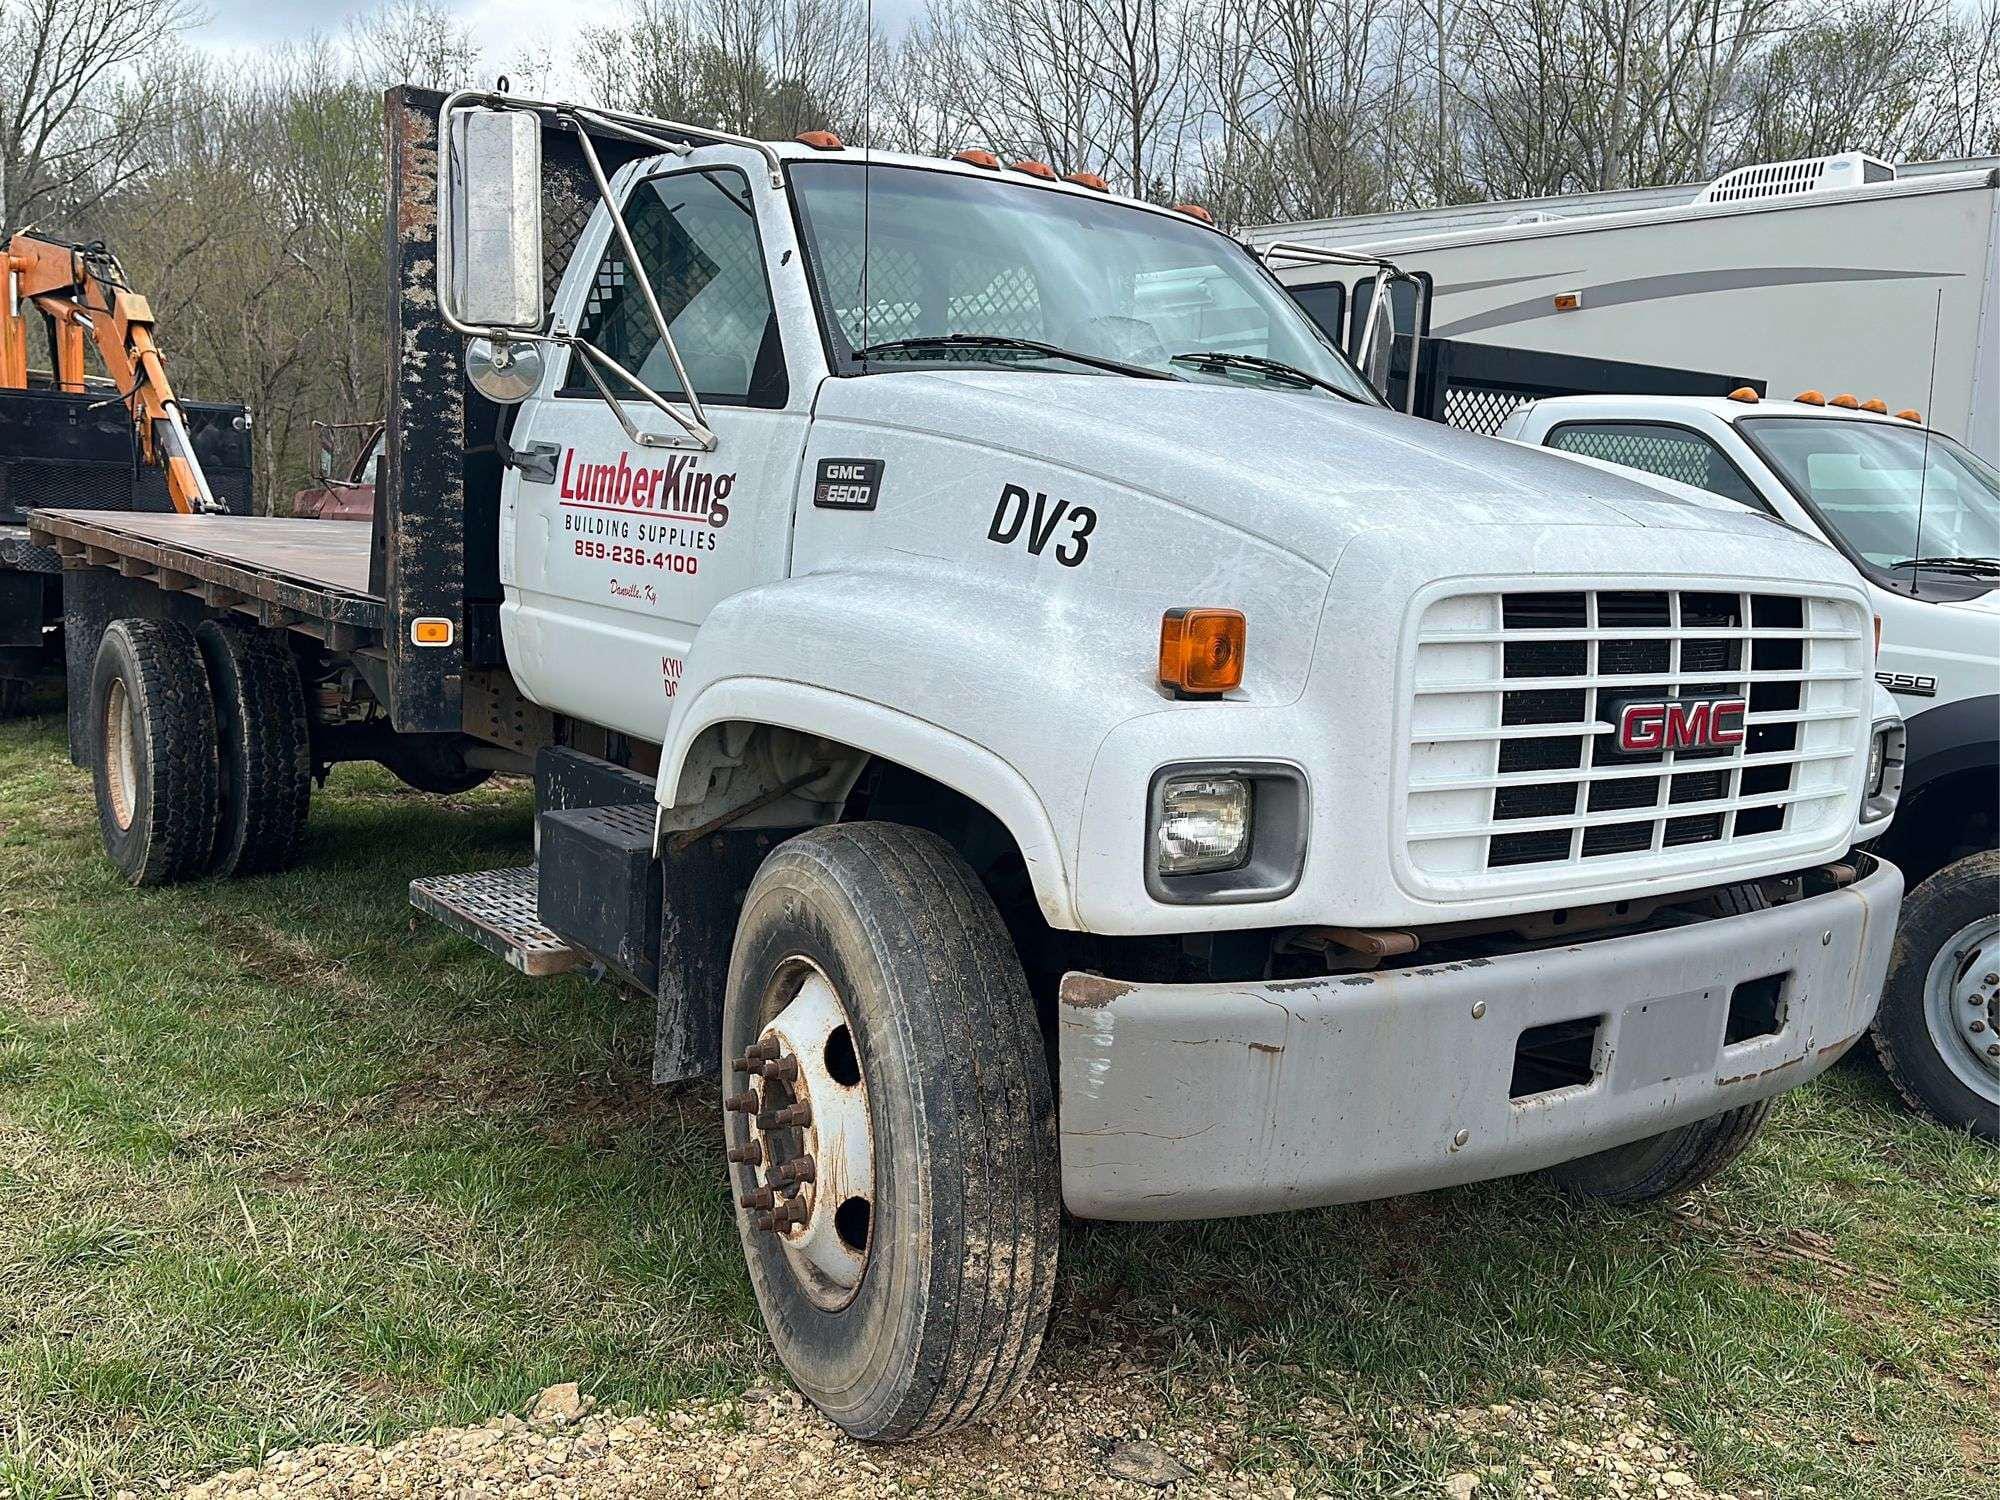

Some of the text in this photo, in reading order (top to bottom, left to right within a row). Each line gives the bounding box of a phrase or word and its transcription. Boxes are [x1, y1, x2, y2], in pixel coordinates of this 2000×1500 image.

[560, 448, 737, 528] LumberKing
[816, 484, 871, 504] C6500
[826, 465, 865, 480] GMC
[565, 514, 716, 551] BUILDING SUPPLIES
[987, 483, 1098, 567] DV3
[1620, 700, 1745, 750] GMC
